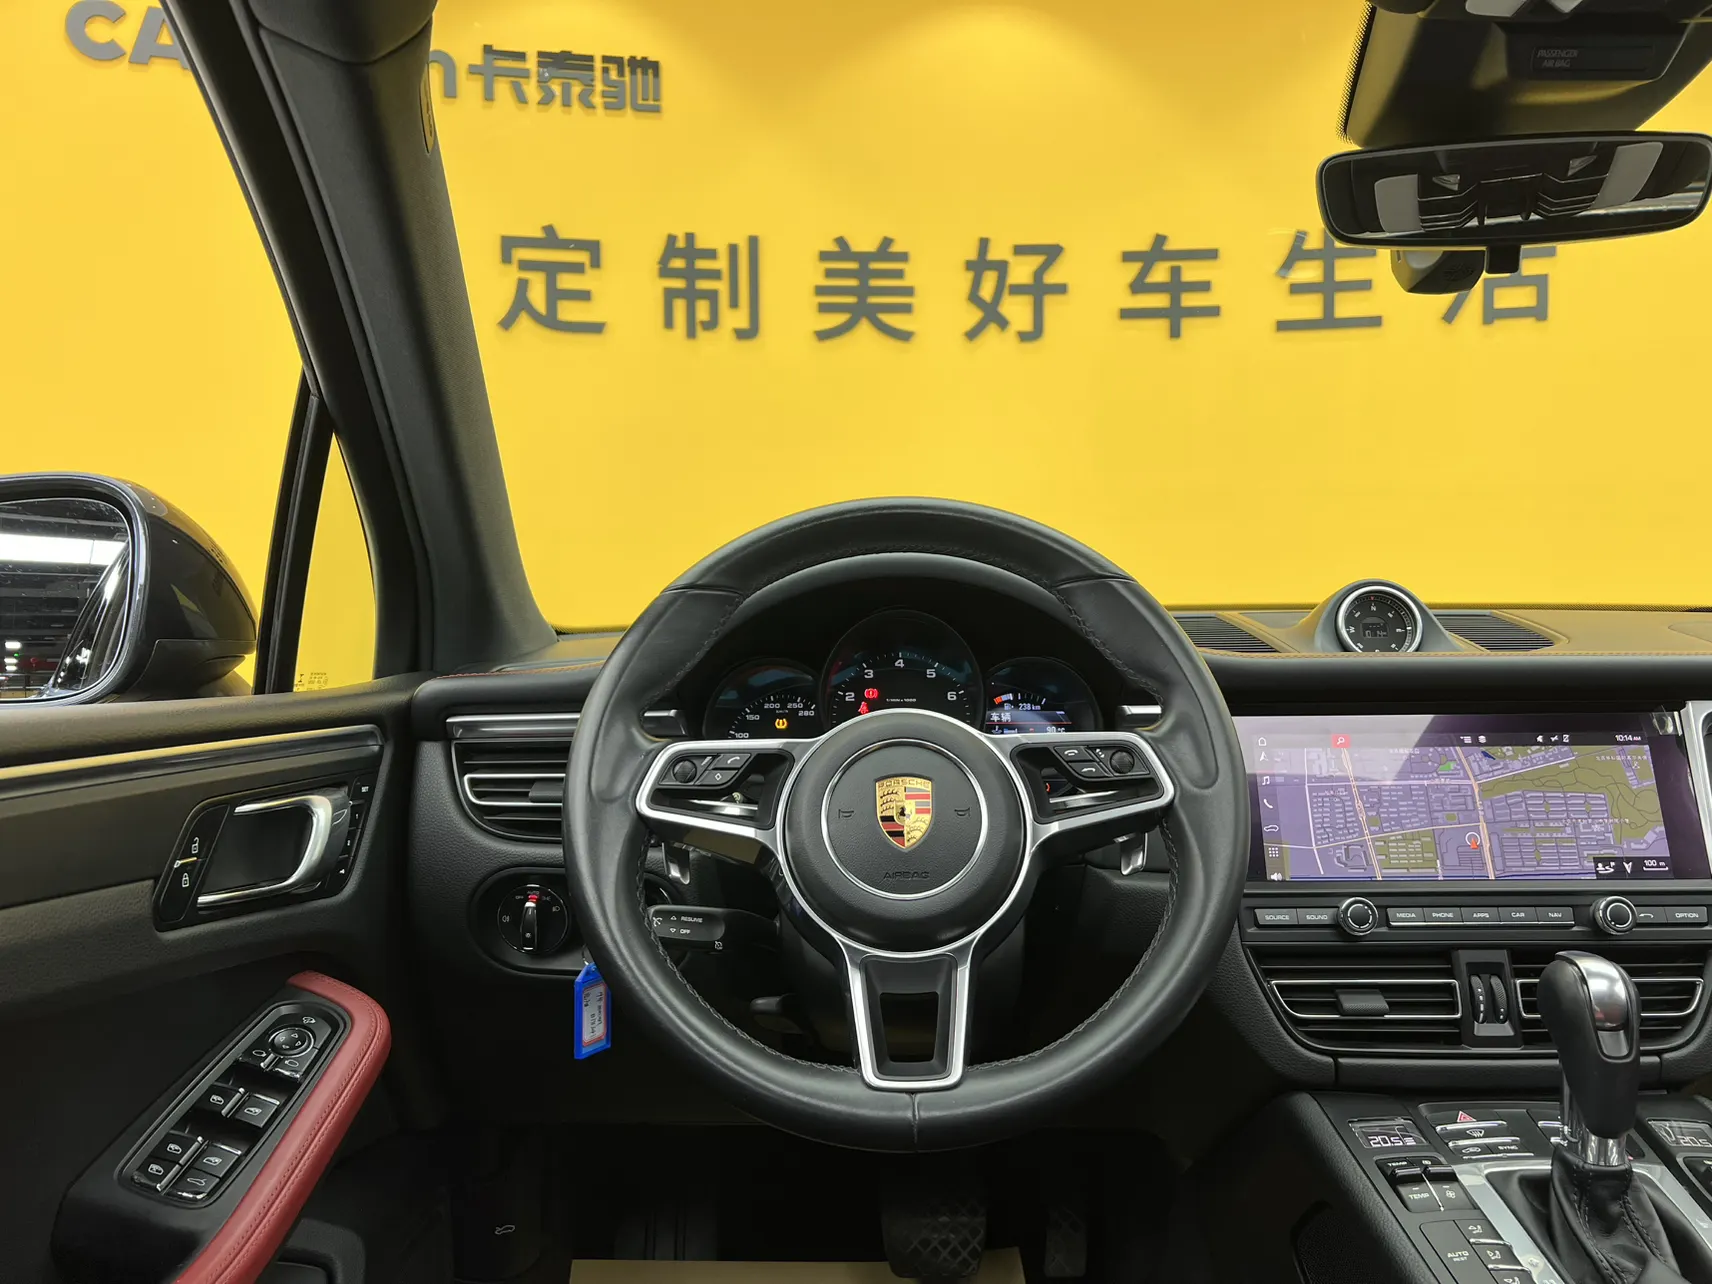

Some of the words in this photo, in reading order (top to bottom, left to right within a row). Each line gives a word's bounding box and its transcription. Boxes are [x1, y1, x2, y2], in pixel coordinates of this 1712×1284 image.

[1537, 49, 1579, 58] PASSENGER
[894, 659, 905, 668] 4
[864, 669, 874, 679] 3
[926, 669, 936, 678] 5
[845, 692, 855, 701] 2
[947, 691, 957, 701] 6
[878, 778, 930, 789] PORSCHE
[883, 871, 930, 880] AIRBAG
[1368, 1135, 1403, 1147] 20.5
[1409, 1192, 1430, 1200] TEMP
[1447, 1250, 1469, 1259] AUTO
